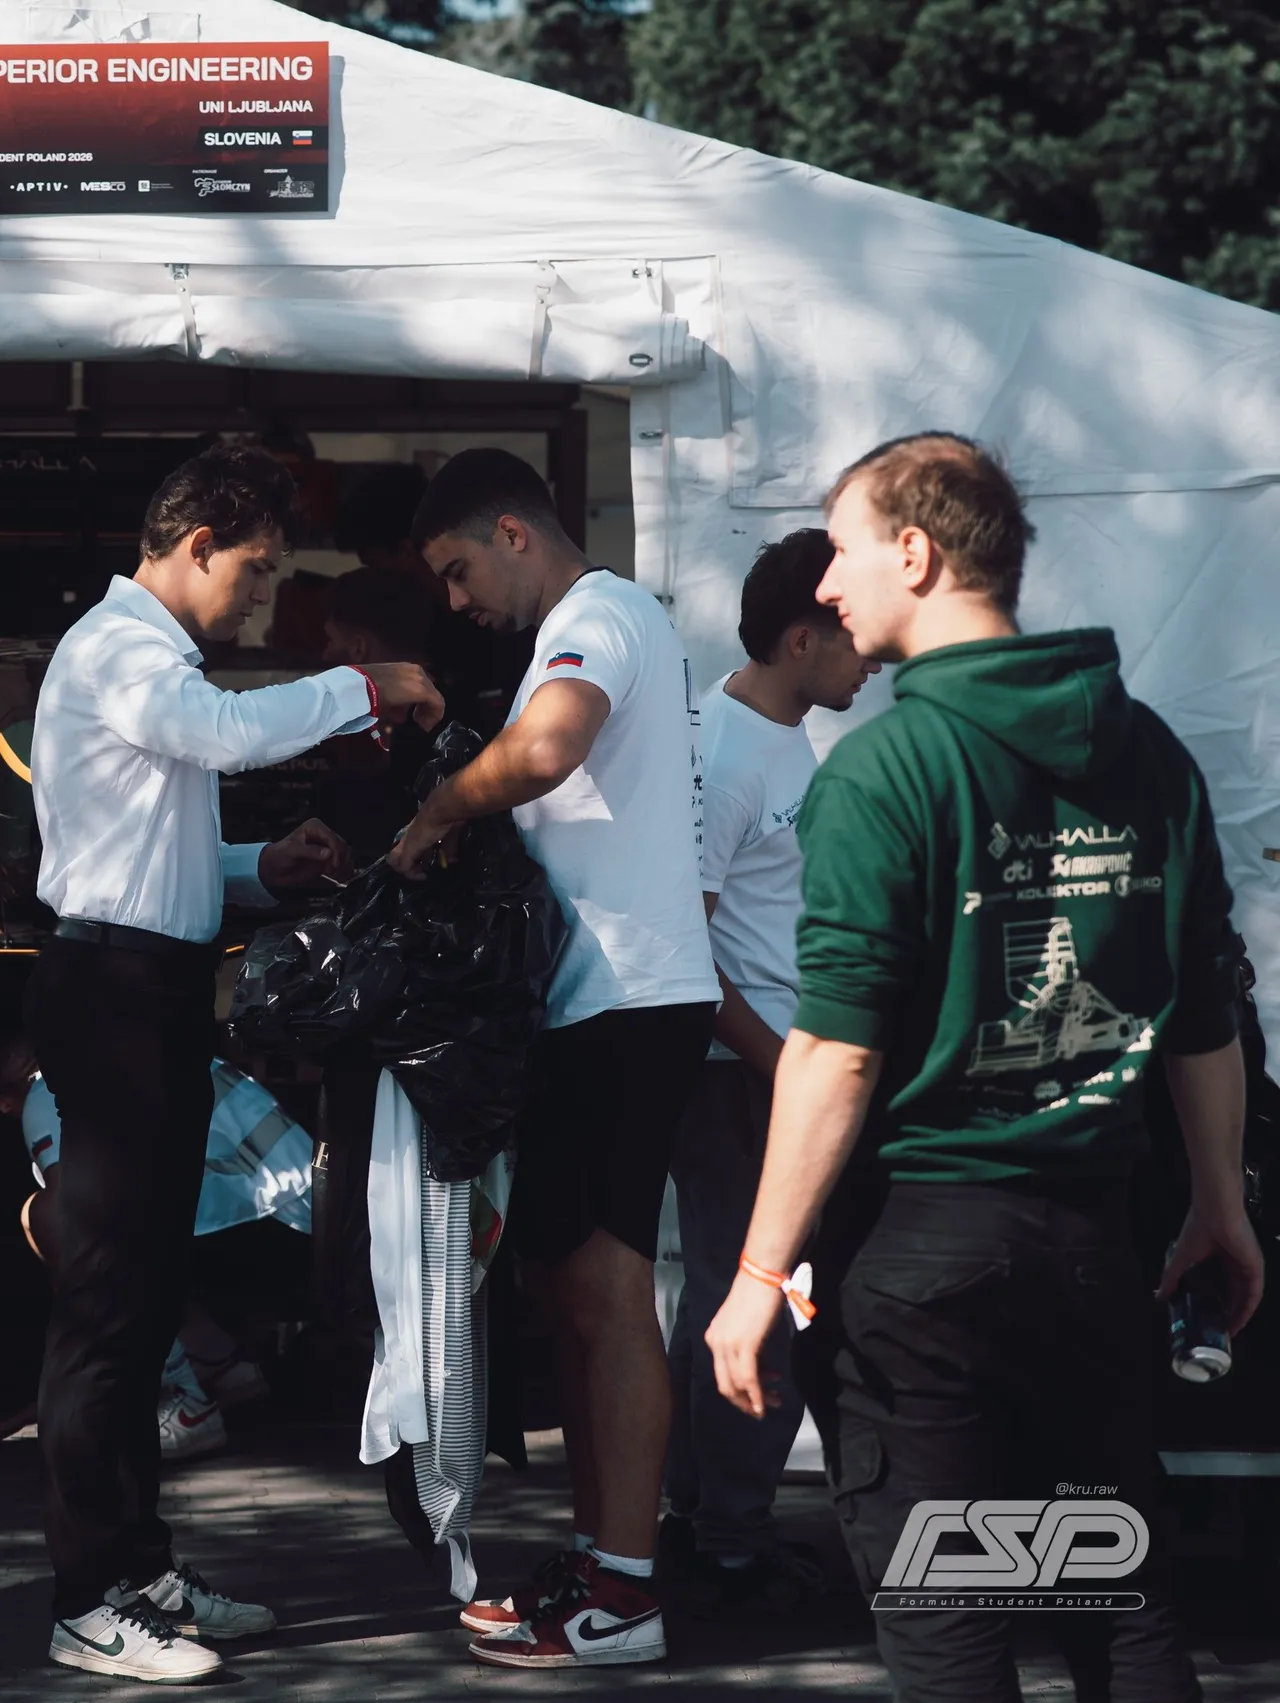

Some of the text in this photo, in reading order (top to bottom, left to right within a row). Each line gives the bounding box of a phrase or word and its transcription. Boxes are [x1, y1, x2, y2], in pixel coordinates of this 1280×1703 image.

[107, 56, 313, 83] ENGINEERING
[199, 100, 313, 114] UNI LJUBLJANA
[204, 132, 282, 146] SLOVENIA
[26, 152, 67, 162] POLAND
[68, 152, 93, 162] 2026
[80, 181, 126, 191] MESCO
[1014, 824, 1139, 851] VALHALLA
[1016, 880, 1111, 900] KOLEKTOR
